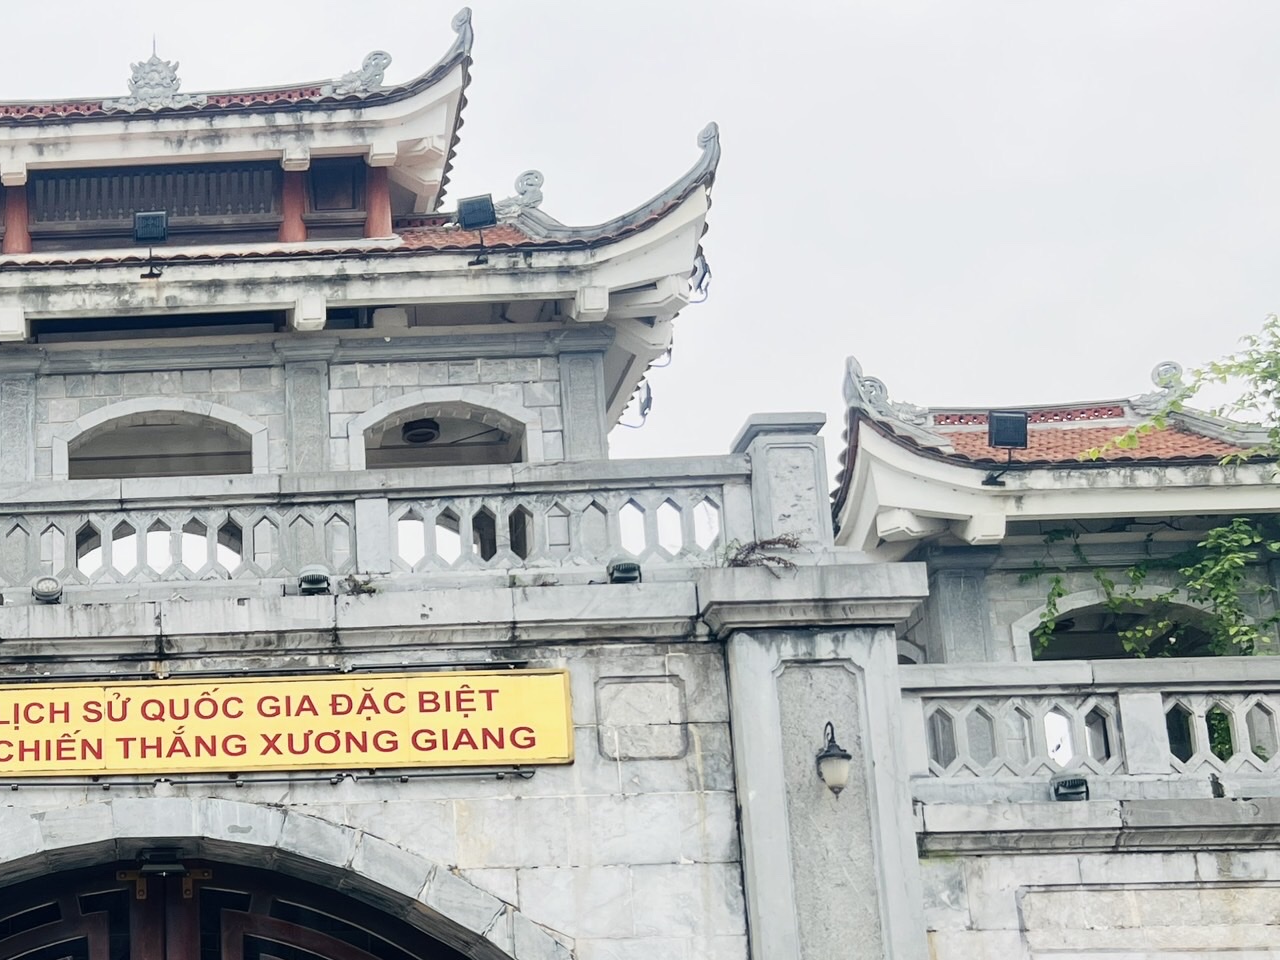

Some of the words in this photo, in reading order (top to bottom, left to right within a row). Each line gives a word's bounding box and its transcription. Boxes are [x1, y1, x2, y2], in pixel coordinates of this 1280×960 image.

[82, 692, 131, 723] SỬ
[140, 687, 244, 723] QUỐC
[256, 694, 319, 718] GIA
[329, 686, 406, 721] ĐẶC
[418, 684, 500, 718] BIỆT
[115, 725, 248, 760] THẮNG
[260, 729, 399, 757] XƯƠNG
[411, 726, 537, 752] GIANG
